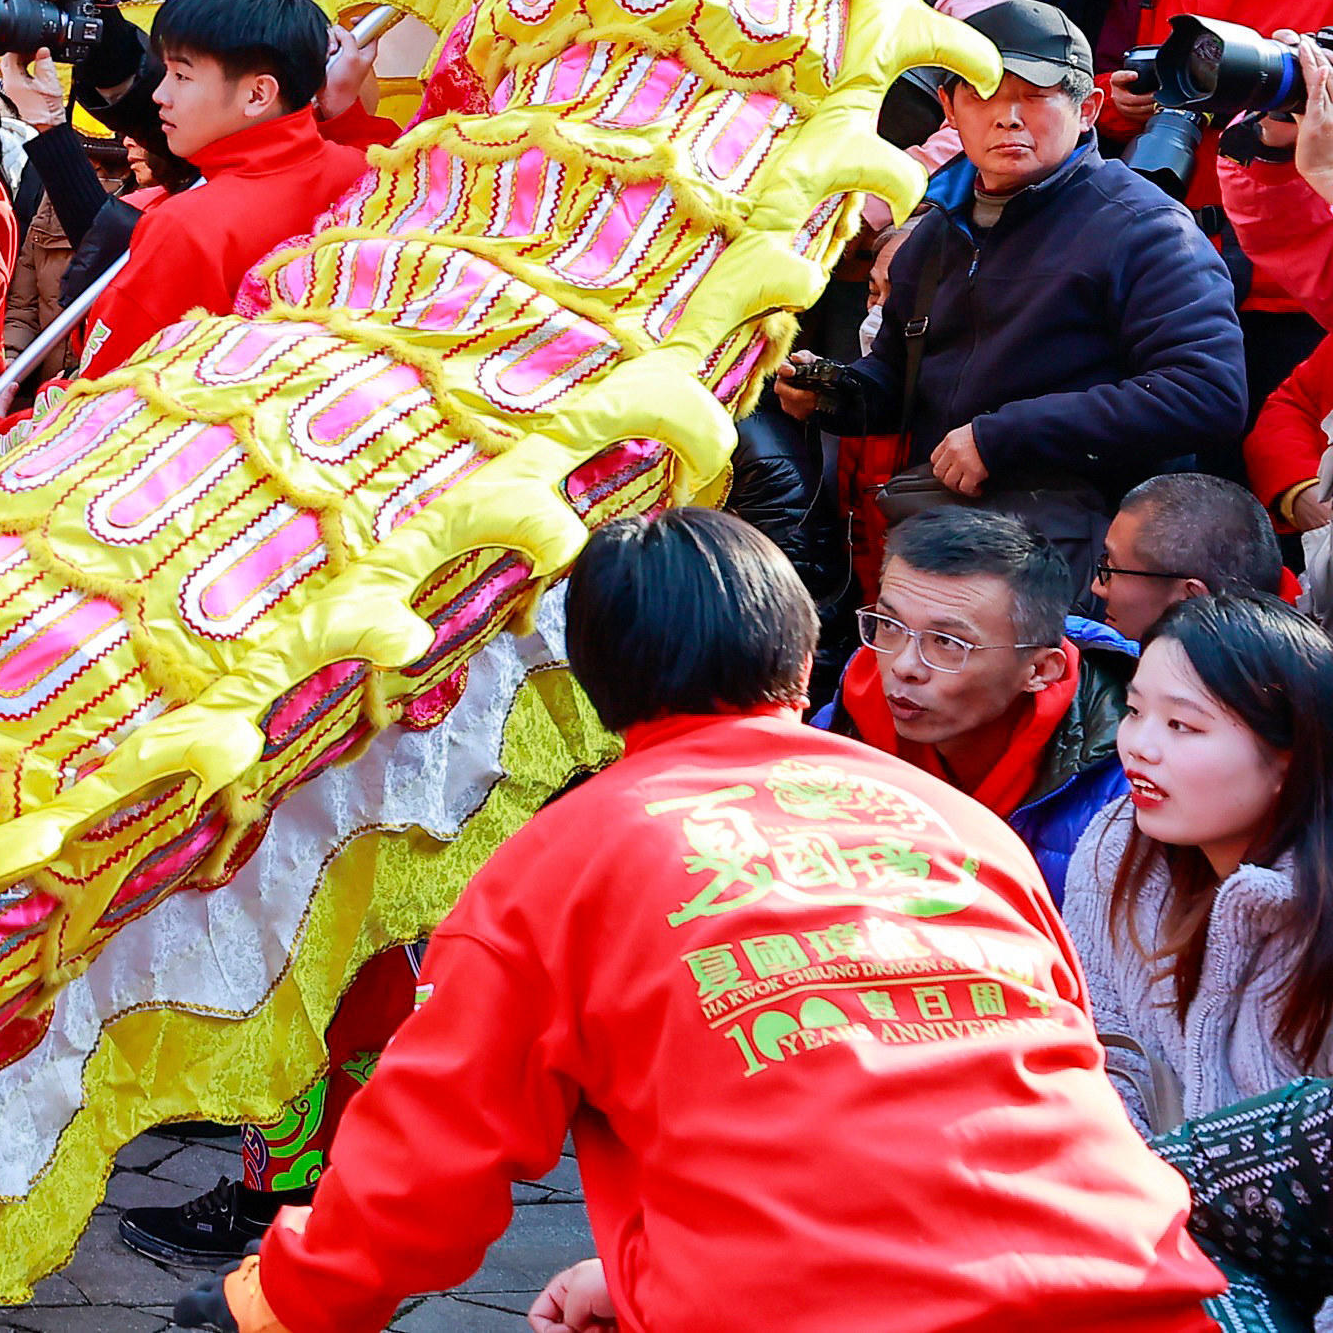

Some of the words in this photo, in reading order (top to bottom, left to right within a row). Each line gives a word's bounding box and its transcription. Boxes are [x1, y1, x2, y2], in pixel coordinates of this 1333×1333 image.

[701, 1001, 728, 1019] HA
[727, 976, 783, 1007] KWOK
[783, 962, 860, 987] CHEUNG
[860, 959, 939, 978] DRAGON
[724, 996, 850, 1077] 100
[777, 1022, 873, 1055] YEARS
